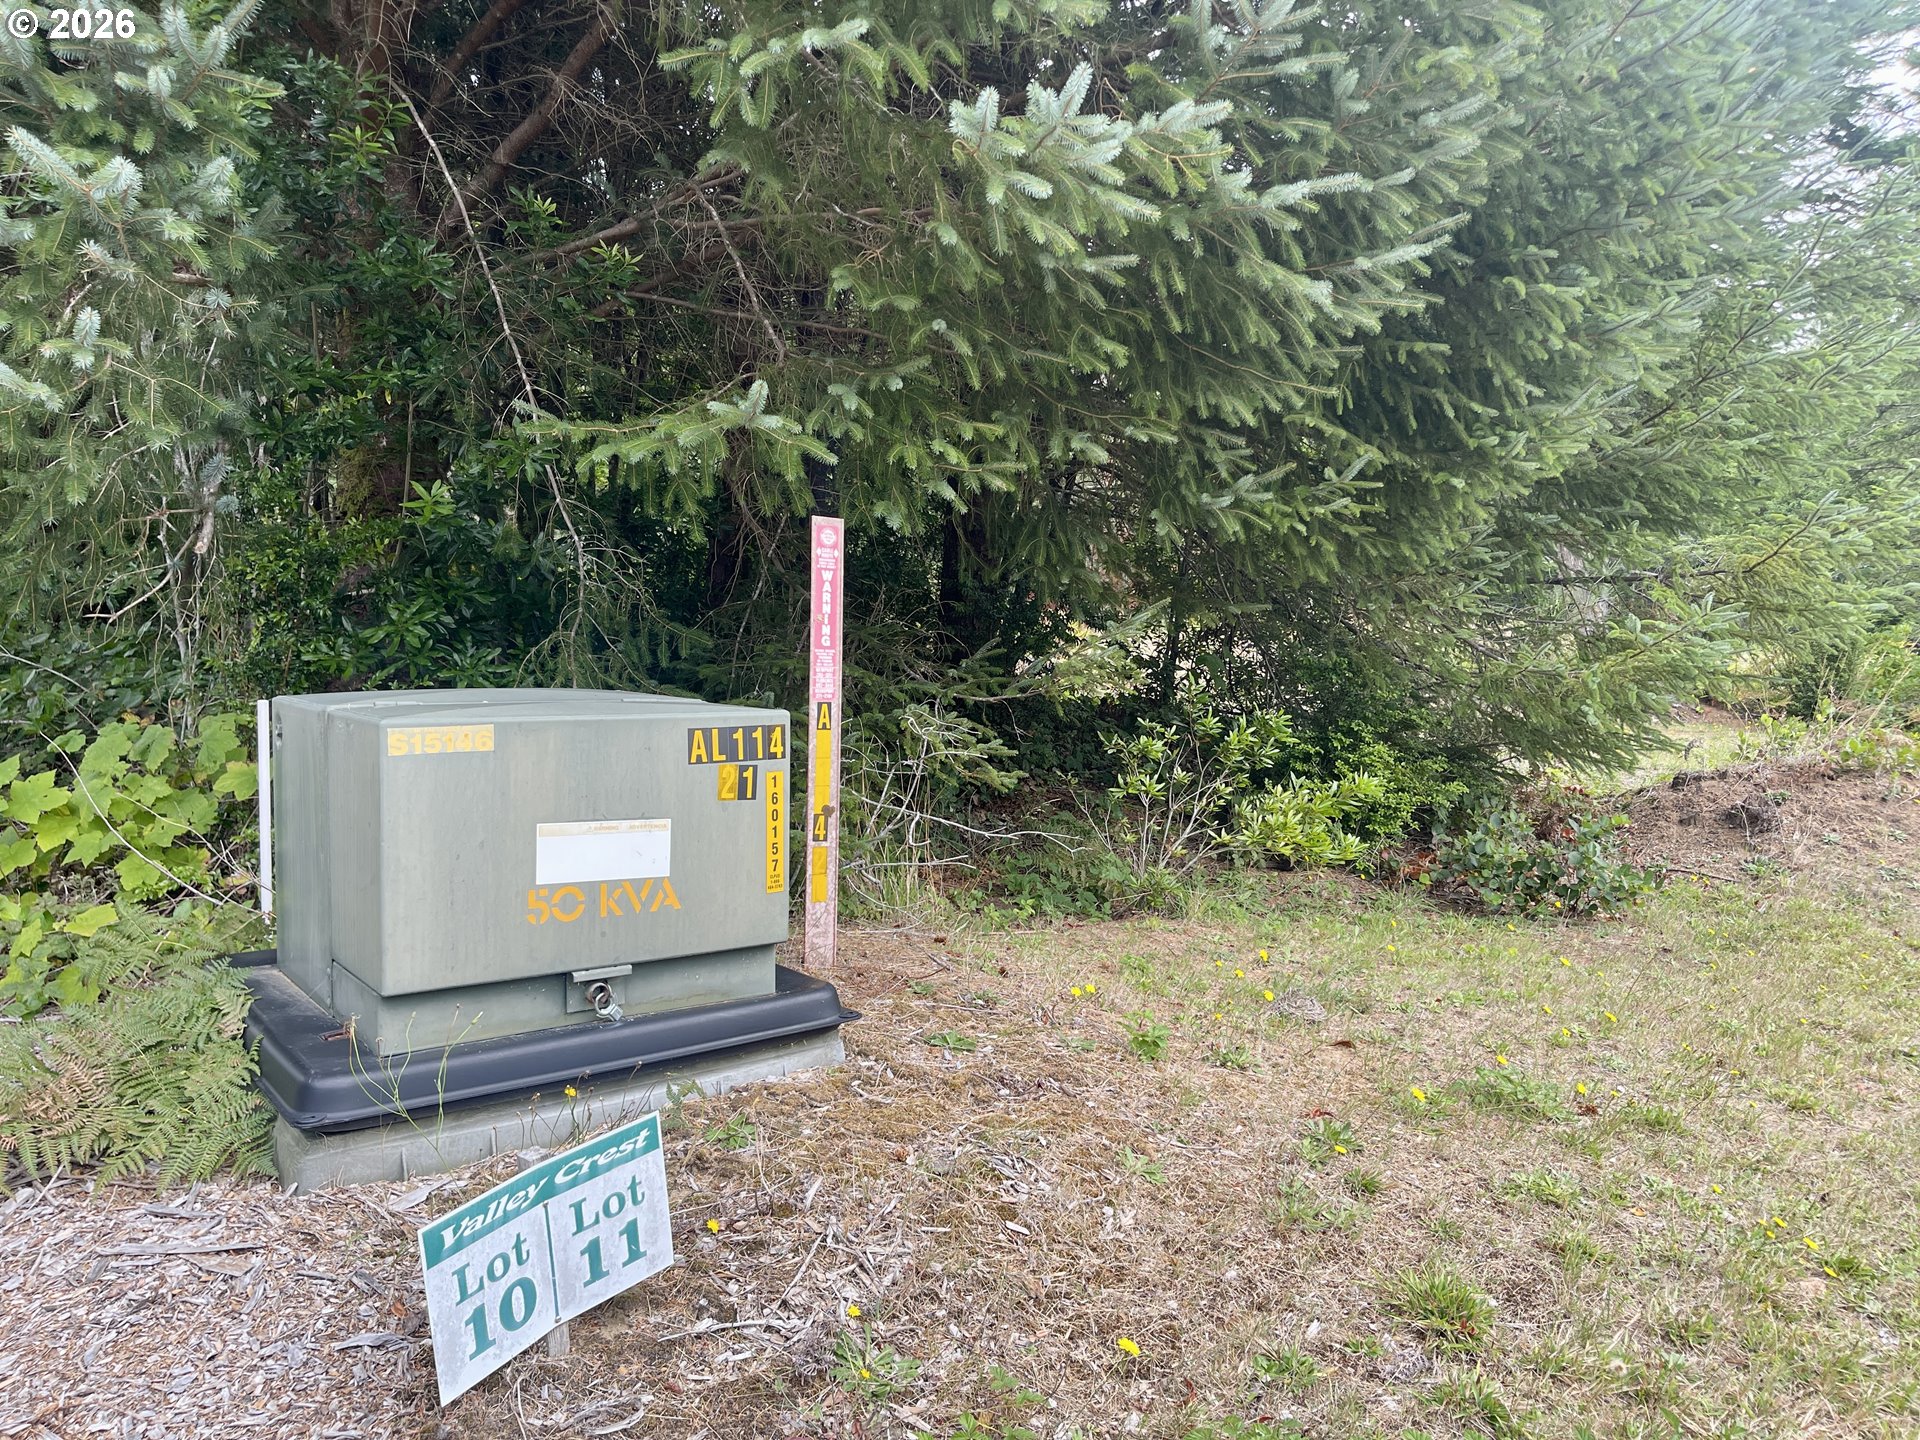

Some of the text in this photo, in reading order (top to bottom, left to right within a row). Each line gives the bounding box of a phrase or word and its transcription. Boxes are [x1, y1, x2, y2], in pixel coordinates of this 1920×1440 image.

[821, 570, 834, 646] WARNING
[690, 726, 784, 763] AL114
[818, 703, 831, 729] A
[721, 766, 753, 799] 21
[771, 775, 779, 872] 160157
[815, 815, 826, 841] 4
[527, 884, 586, 925] 50
[440, 1127, 651, 1250] Valley Crest
[569, 1174, 646, 1237] Lot
[452, 1232, 531, 1306] Lot
[580, 1217, 647, 1288] 11
[464, 1276, 538, 1361] 10
